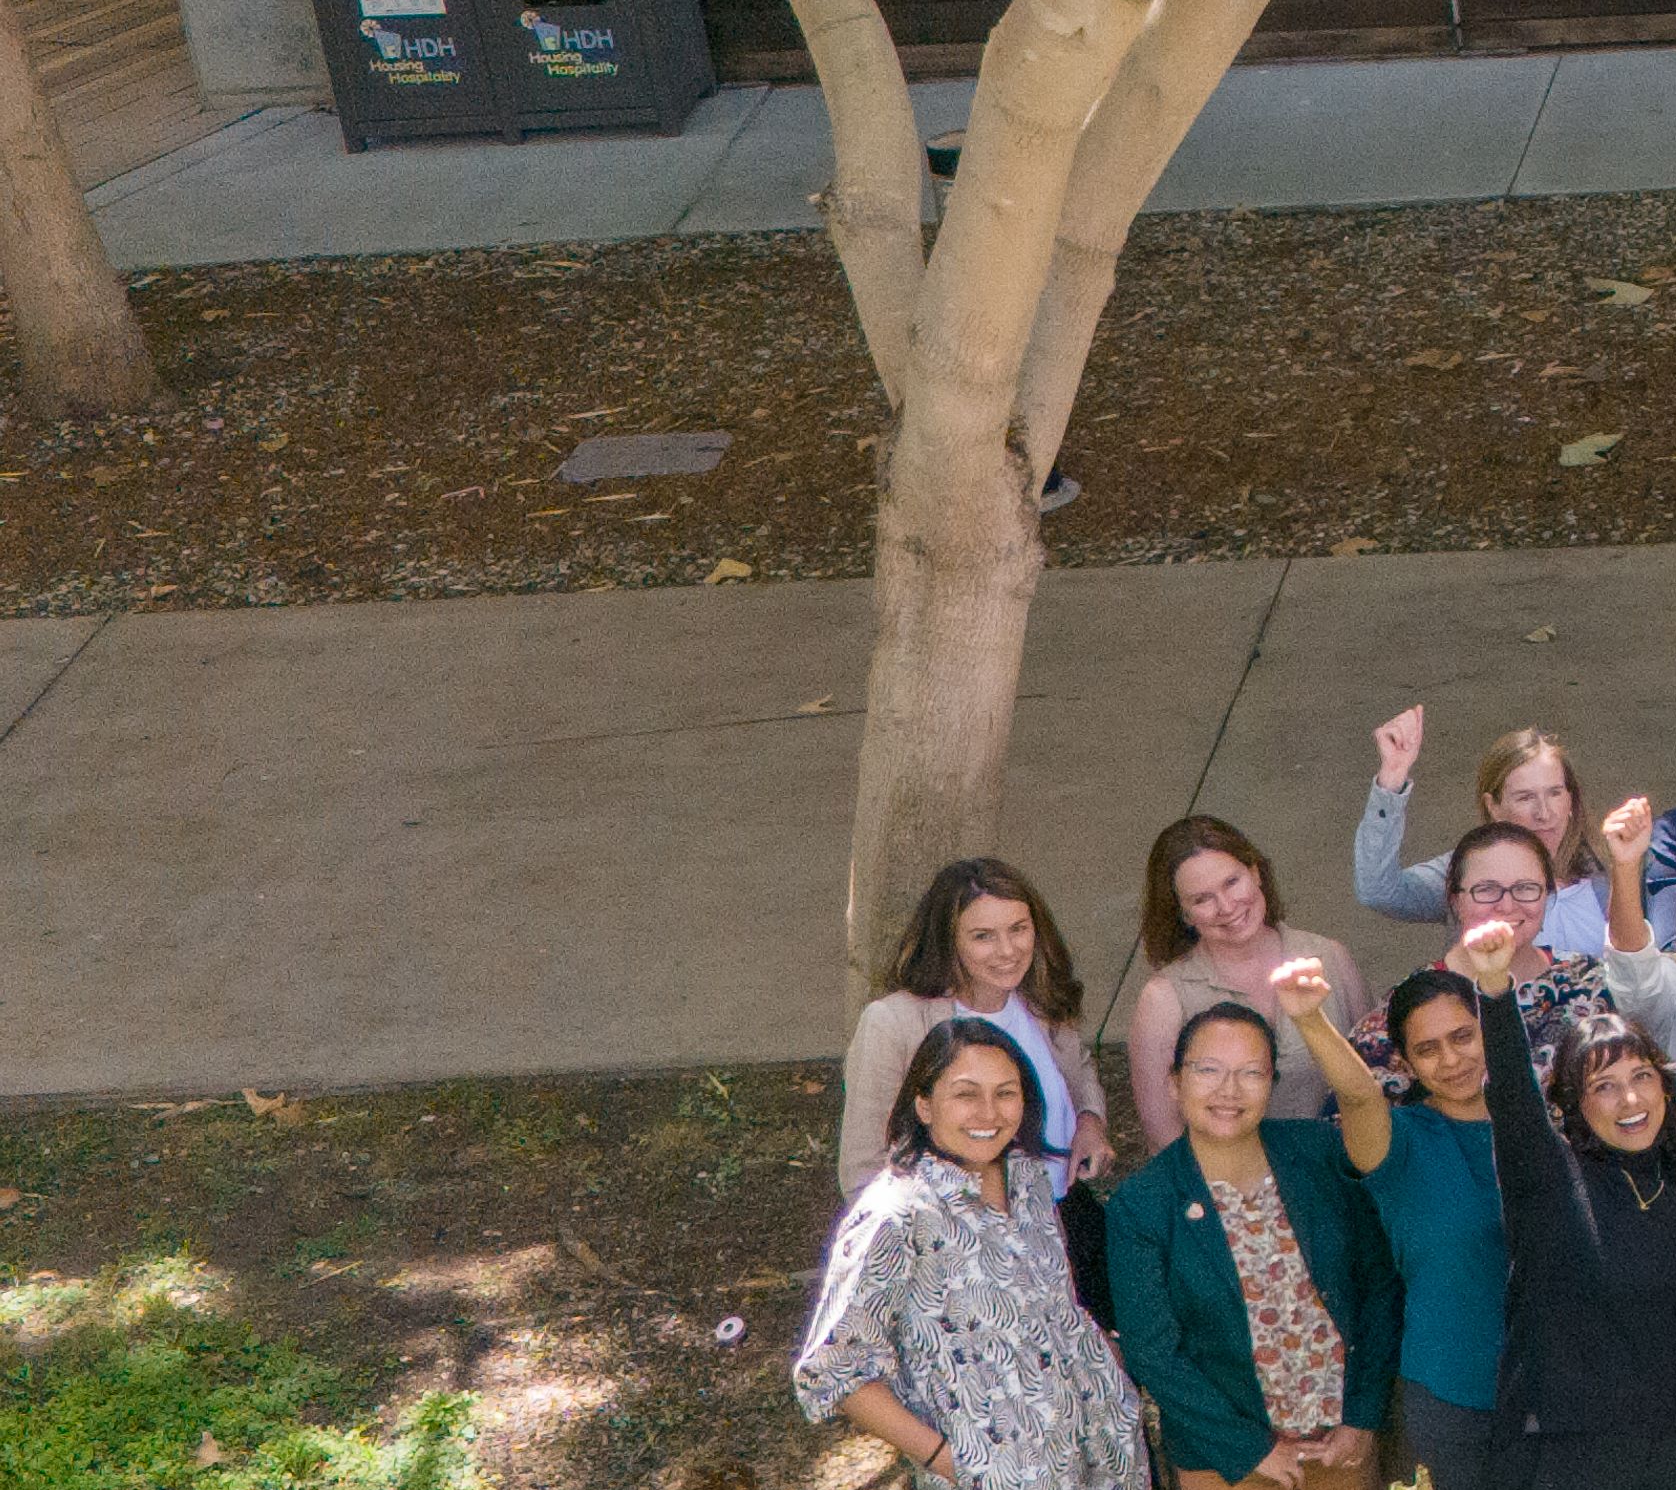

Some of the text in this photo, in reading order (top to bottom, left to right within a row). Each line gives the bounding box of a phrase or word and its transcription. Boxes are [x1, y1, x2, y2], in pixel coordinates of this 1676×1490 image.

[563, 29, 615, 50] HDH
[404, 38, 457, 58] HDH
[528, 50, 583, 65] Housing
[369, 59, 425, 74] Housing
[547, 63, 619, 79] Hospitality
[388, 71, 462, 87] Hospitality
